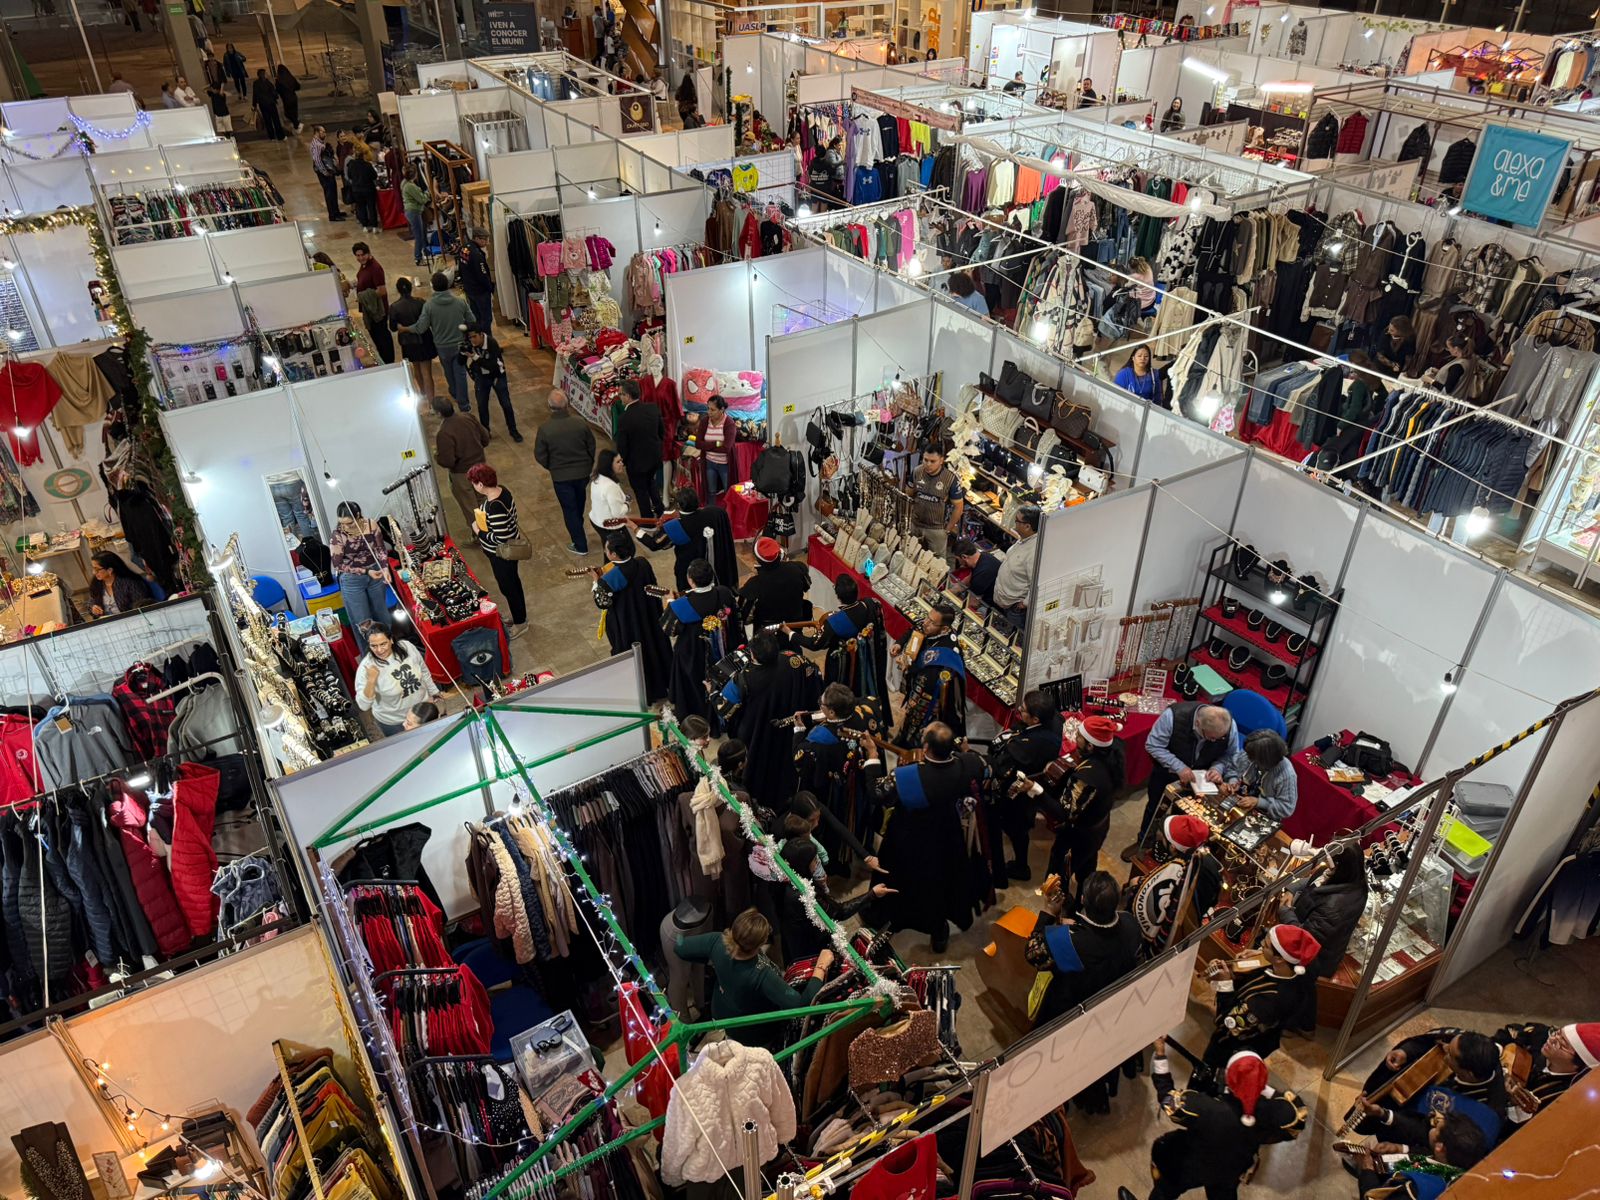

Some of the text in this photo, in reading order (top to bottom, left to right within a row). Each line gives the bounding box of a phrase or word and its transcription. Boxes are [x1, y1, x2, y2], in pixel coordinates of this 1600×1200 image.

[509, 21, 516, 29] A
[738, 22, 767, 32] UASLP
[490, 29, 528, 37] CONOCER
[1493, 149, 1546, 180] alexa
